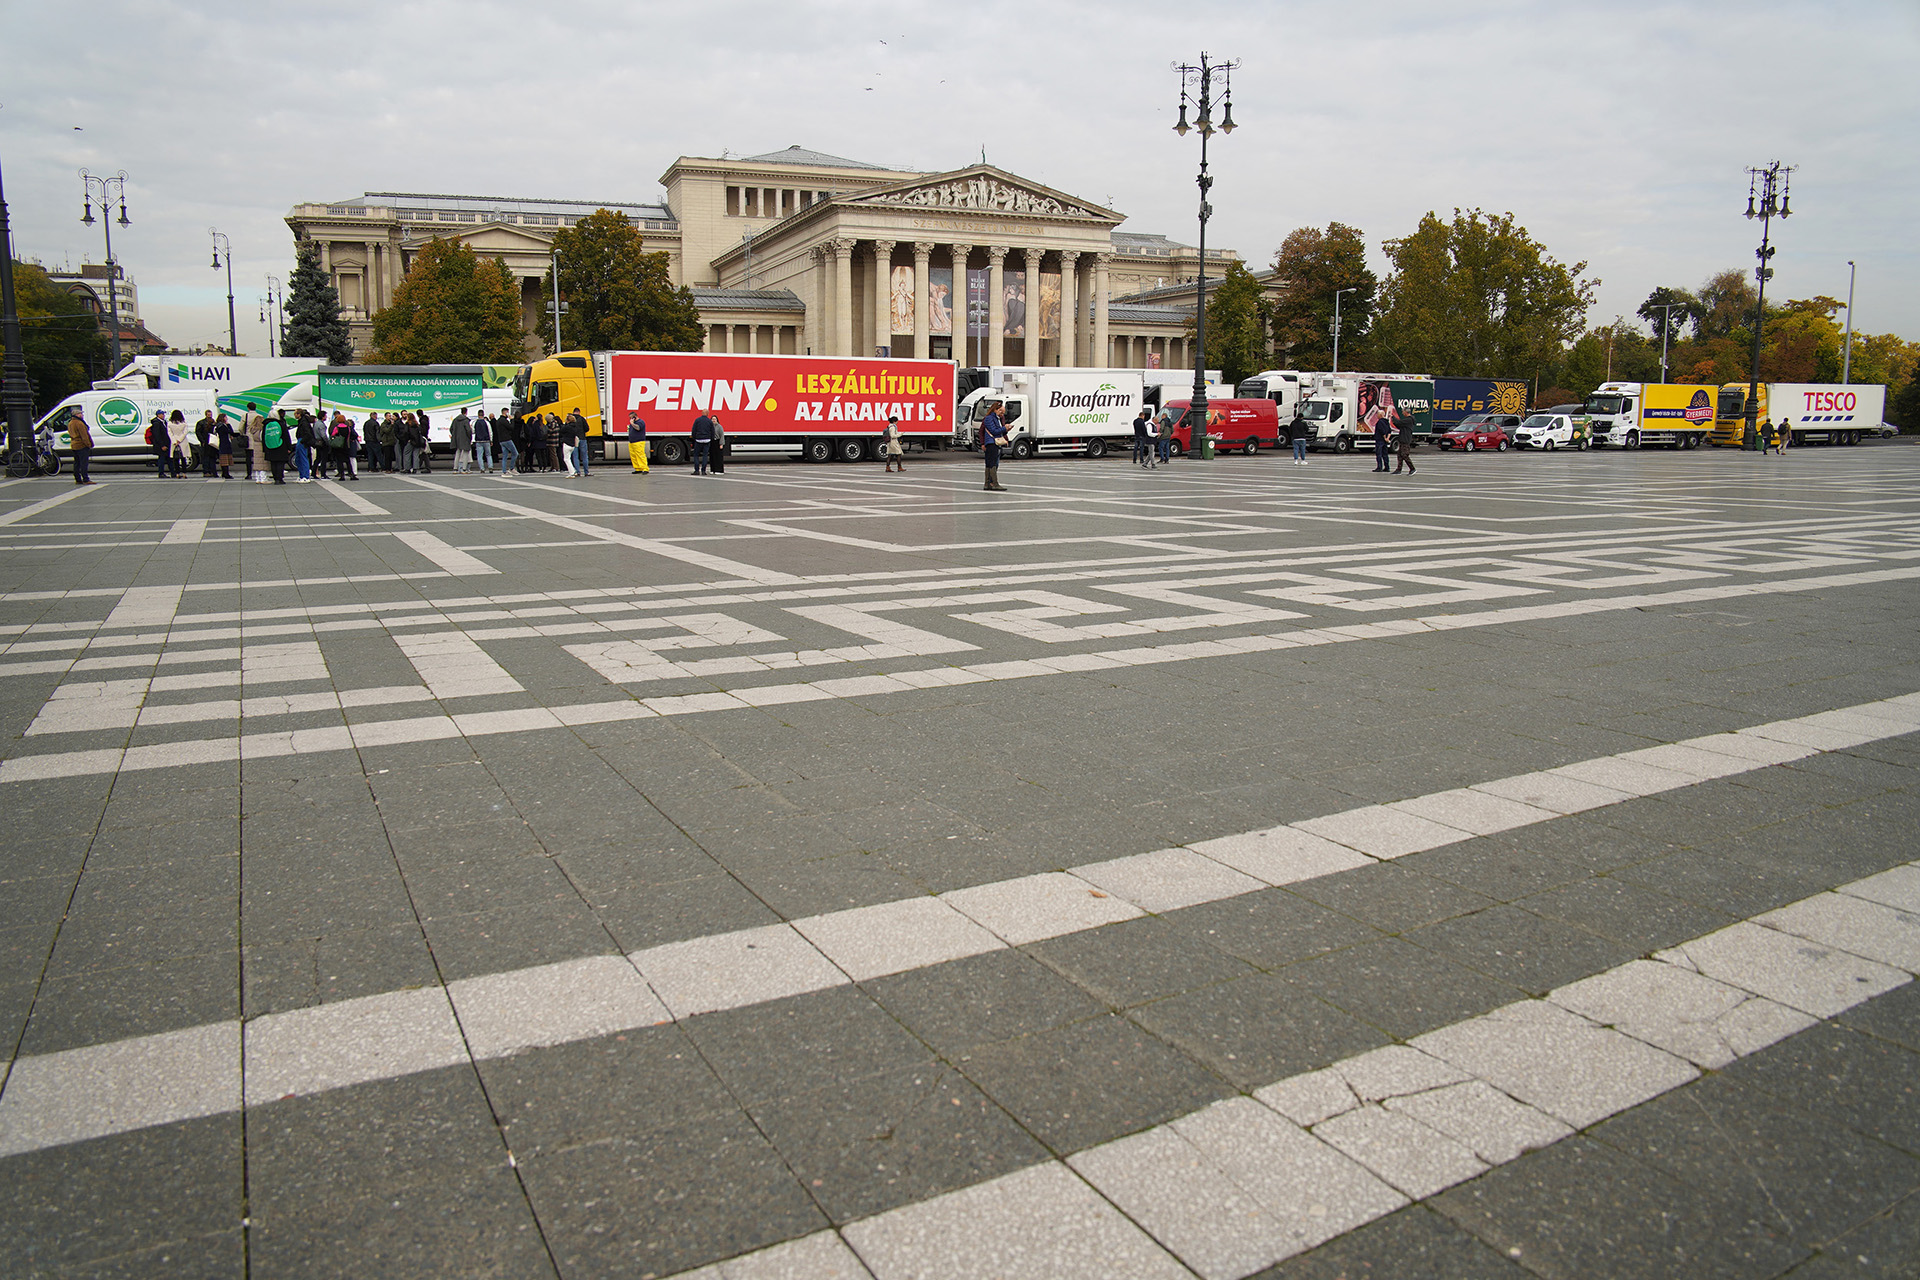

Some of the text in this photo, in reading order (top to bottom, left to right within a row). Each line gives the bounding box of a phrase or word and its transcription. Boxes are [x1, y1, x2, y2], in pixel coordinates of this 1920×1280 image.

[191, 366, 231, 381] HAVI
[325, 377, 479, 386] XX. ÉLELMISZERBANK ADOMÁNYKONVOJ
[796, 369, 943, 396] LESZÁLLÍTJUK.
[386, 389, 422, 397] Élelmezési
[146, 400, 174, 408] Magyar
[389, 398, 420, 406] Világnap
[1049, 389, 1131, 412] Bonafarm
[1397, 399, 1429, 409] KOMETA
[1803, 392, 1857, 412] TESCO
[794, 402, 824, 421] AZ
[828, 396, 914, 421] ÁRAKAT
[1685, 409, 1713, 418] GYERMELYI
[1069, 413, 1110, 424] CSOPORT
